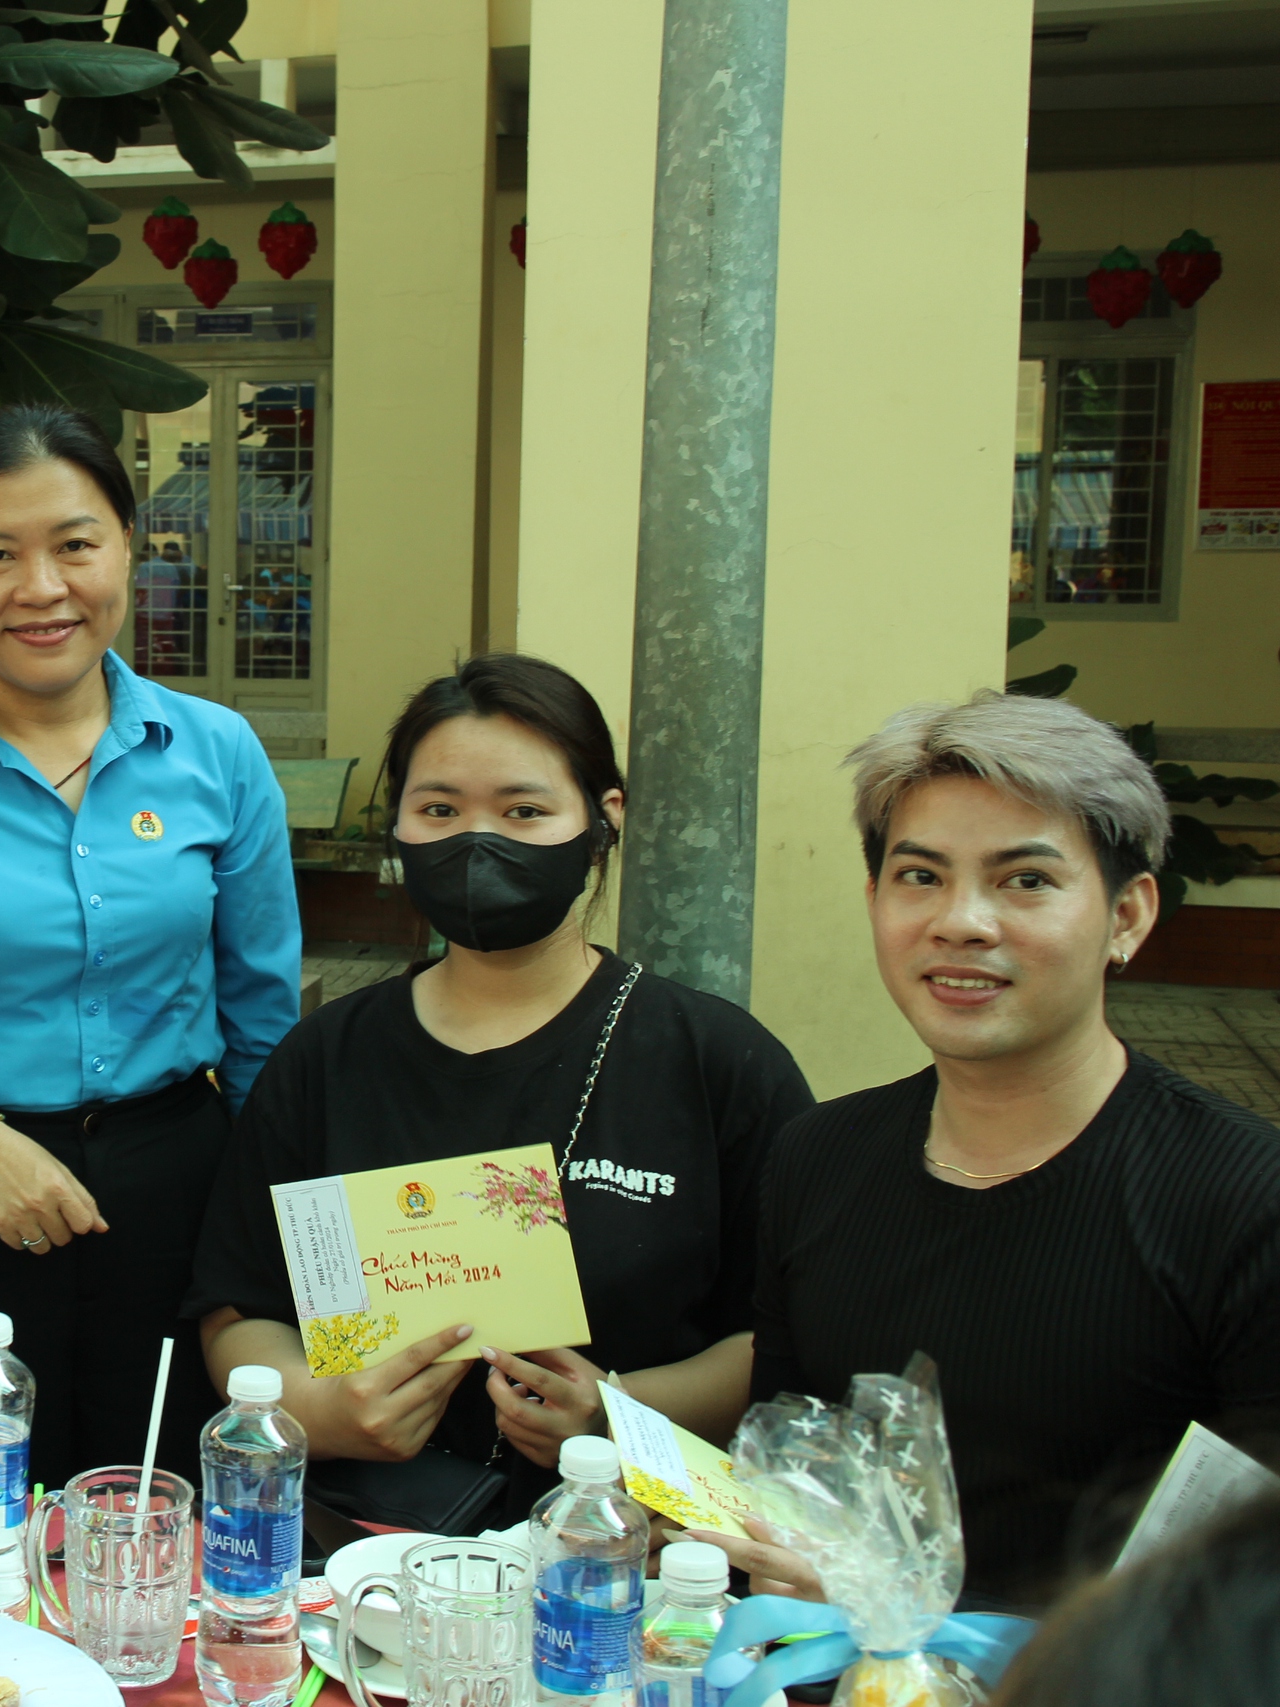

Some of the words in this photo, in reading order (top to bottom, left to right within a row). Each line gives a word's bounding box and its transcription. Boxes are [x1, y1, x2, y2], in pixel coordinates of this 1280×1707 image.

[568, 1158, 676, 1196] KARANTS
[609, 1184, 617, 1193] in
[285, 1198, 294, 1212] ĐỨC
[288, 1213, 299, 1237] TP.THỦ
[304, 1217, 316, 1235] QUÀ
[294, 1239, 304, 1258] ĐỘNG
[310, 1236, 321, 1259] NHẬN
[299, 1259, 307, 1273] LAO
[315, 1261, 326, 1286] PHIẾU
[361, 1252, 408, 1276] Chúc
[410, 1251, 462, 1274] Mừng
[302, 1275, 311, 1293] ĐOÀN
[384, 1276, 424, 1292] Năm
[426, 1266, 456, 1288] Mới
[463, 1264, 502, 1283] 2024
[306, 1294, 315, 1310] LIÊN
[204, 1526, 261, 1560] QUAFINA
[533, 1620, 579, 1654] AFINA
